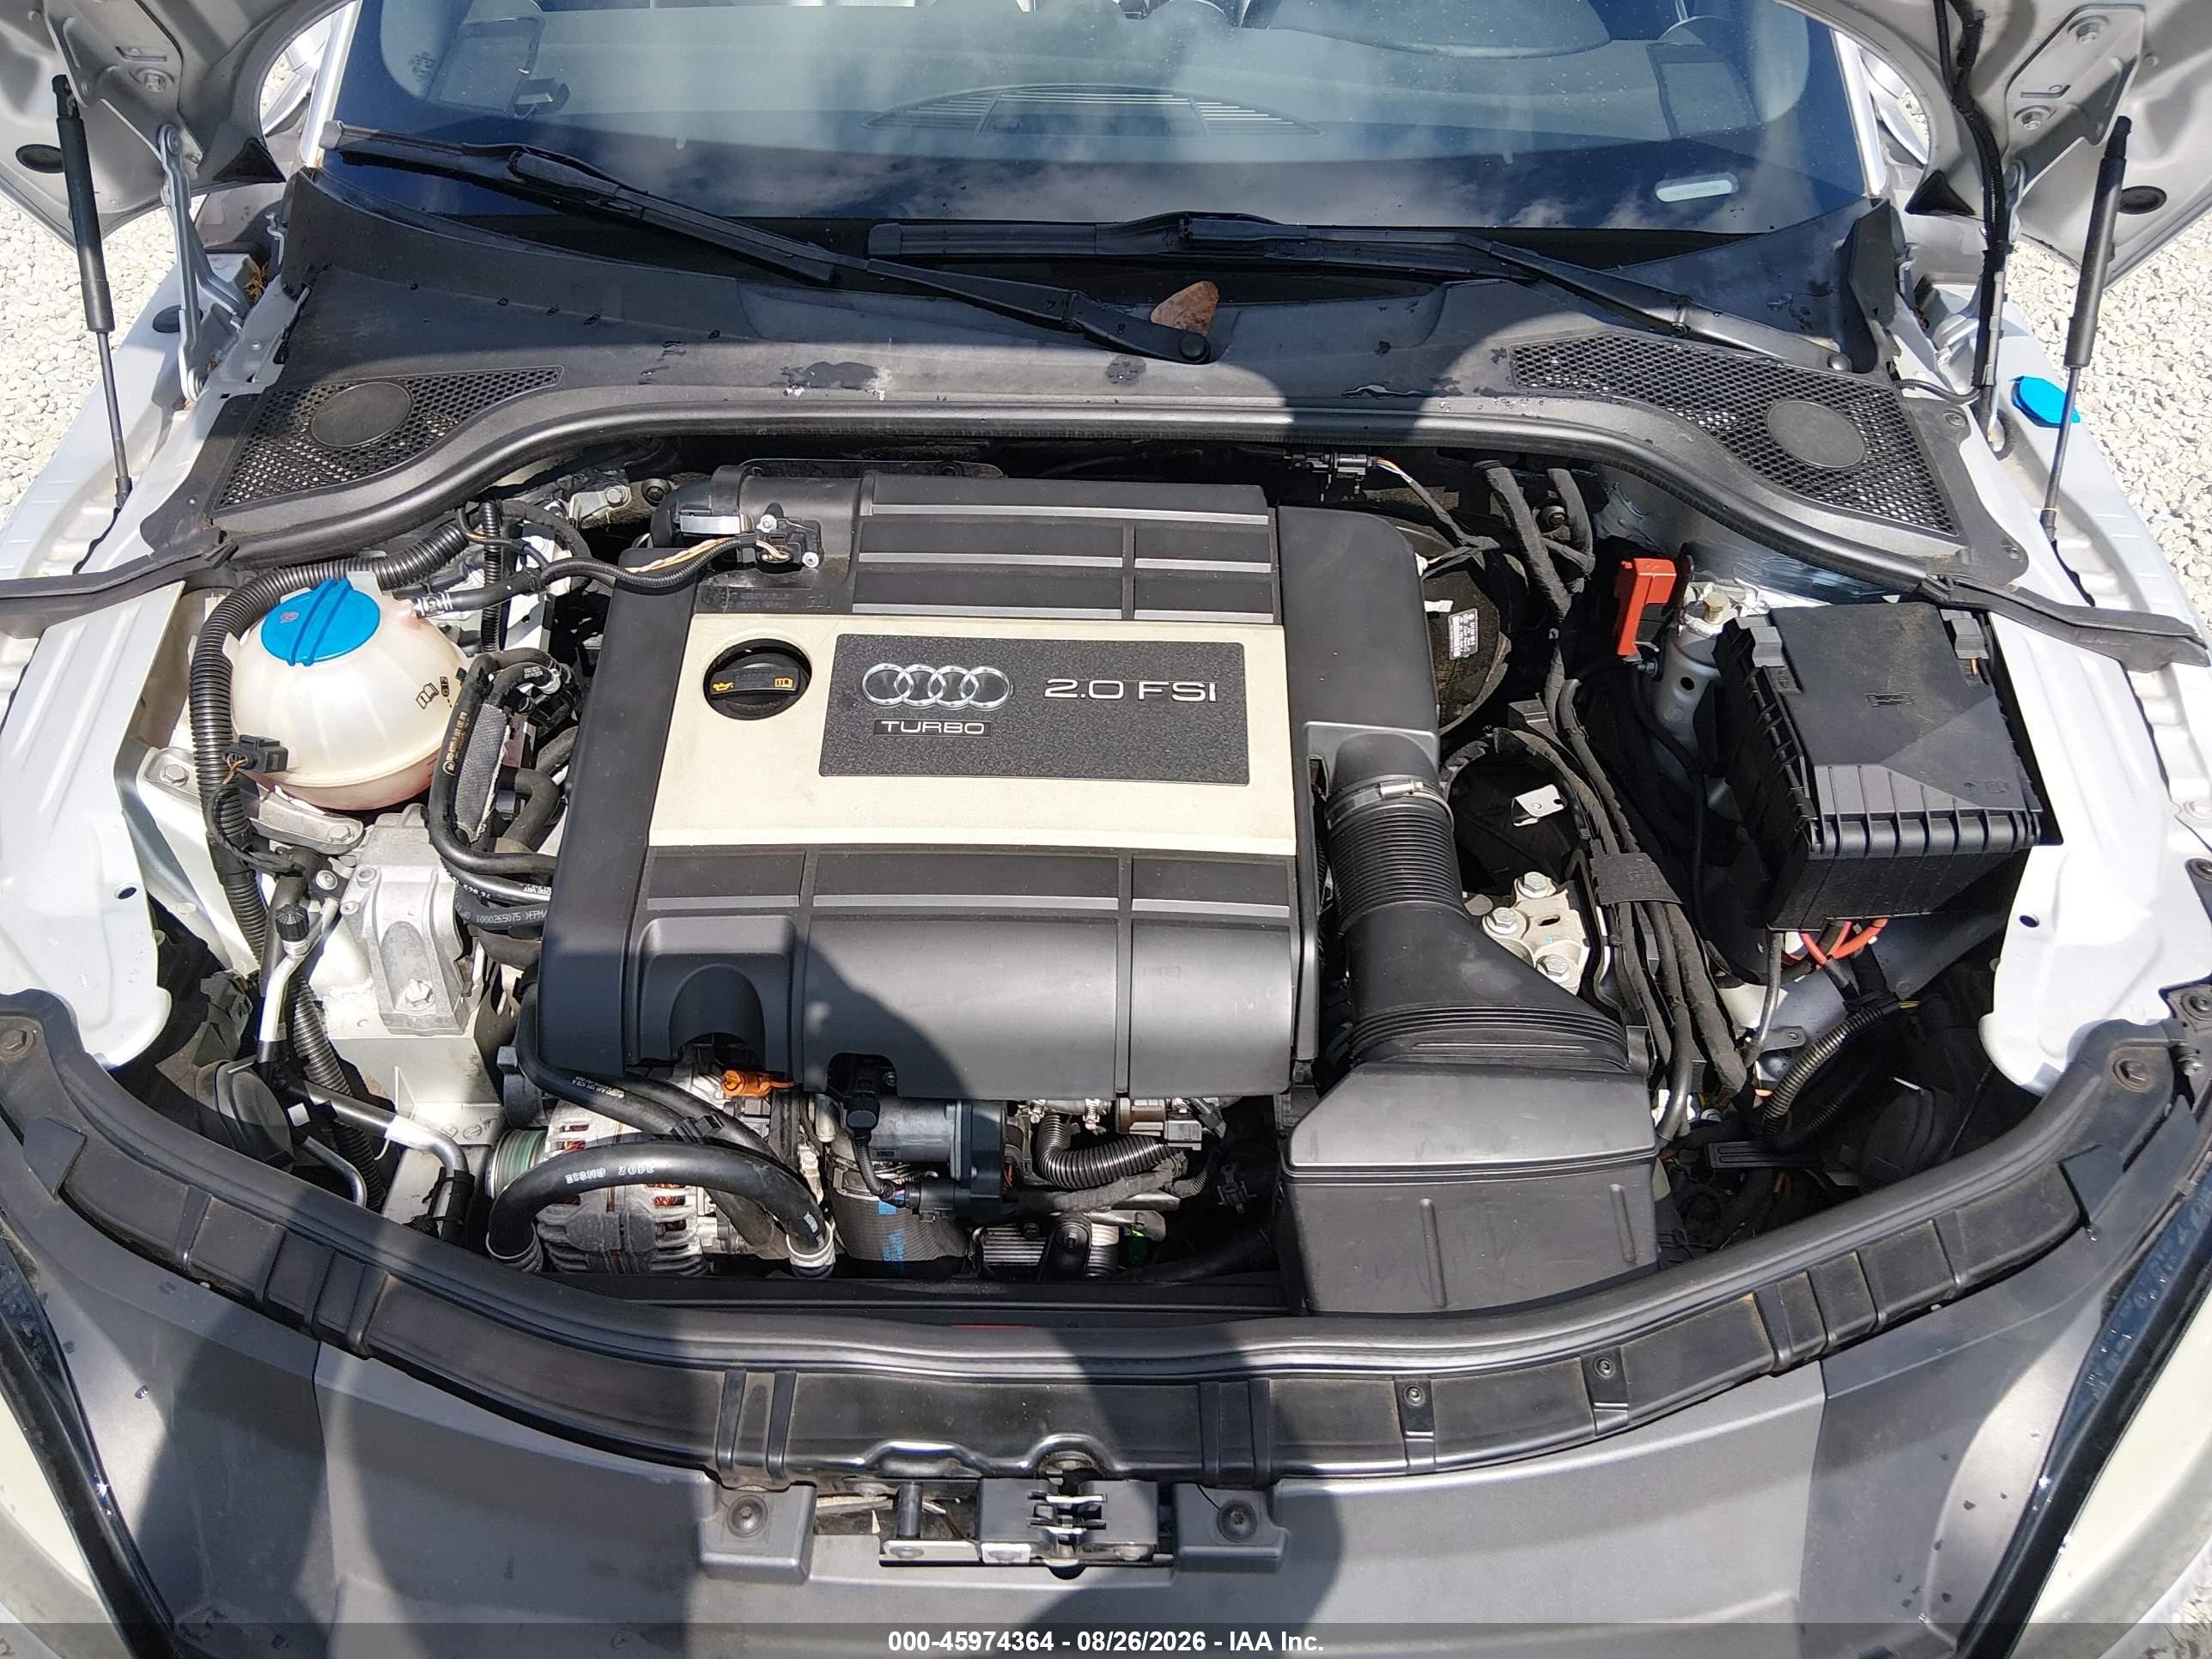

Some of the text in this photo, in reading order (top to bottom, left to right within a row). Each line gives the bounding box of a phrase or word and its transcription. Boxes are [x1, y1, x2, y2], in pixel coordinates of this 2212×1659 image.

[1044, 678, 1217, 702] 2.0 FSI
[881, 720, 985, 735] TURBO
